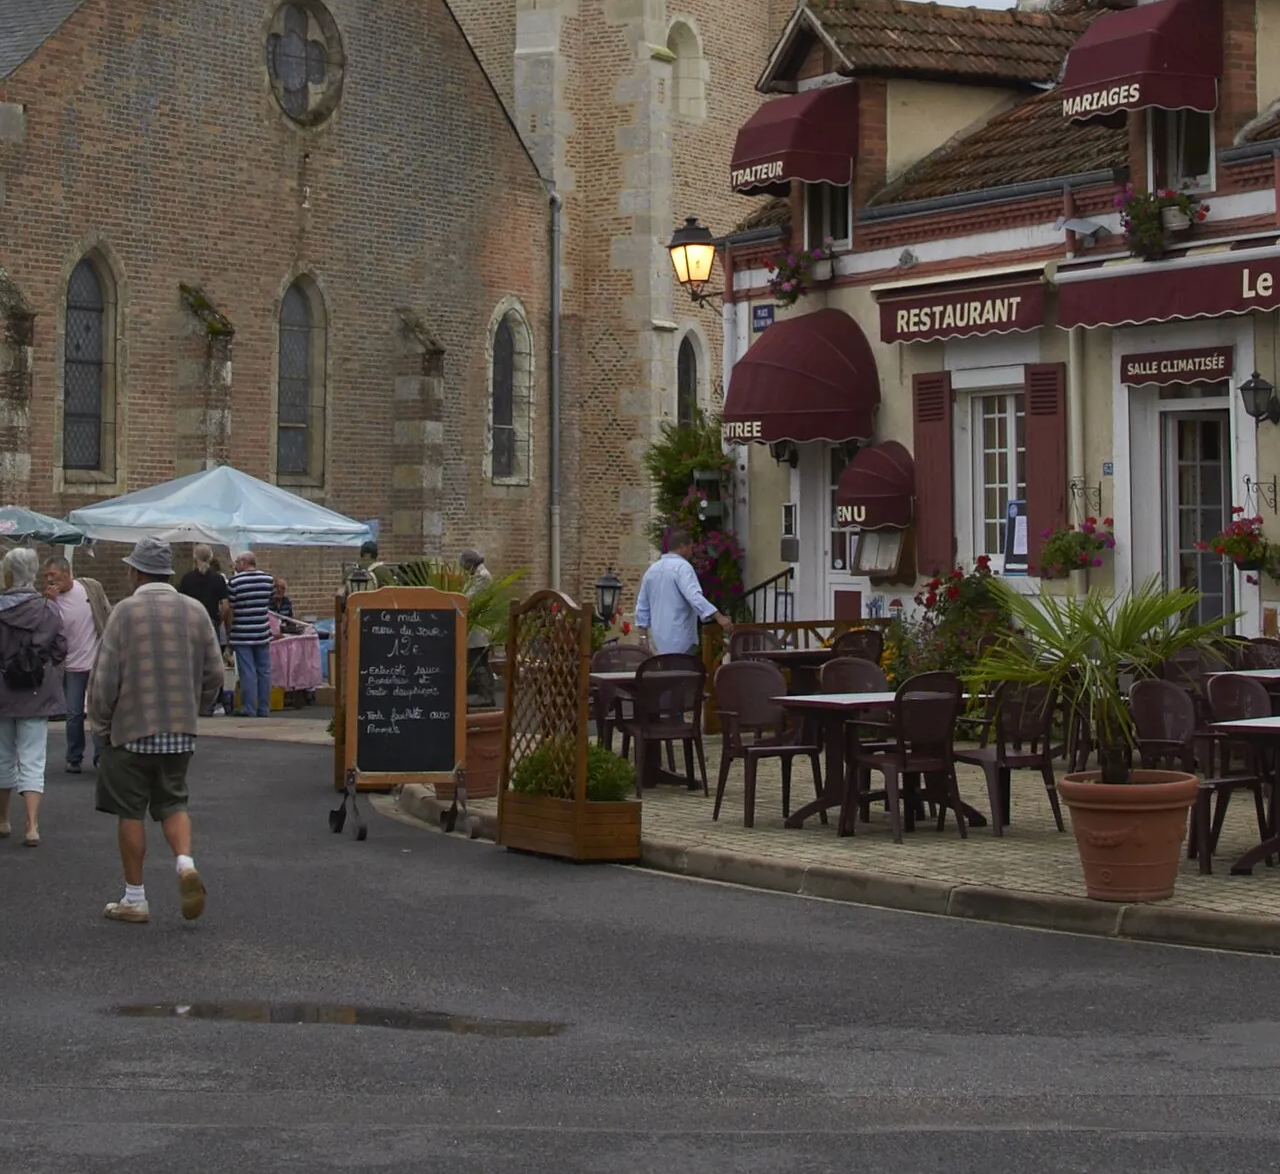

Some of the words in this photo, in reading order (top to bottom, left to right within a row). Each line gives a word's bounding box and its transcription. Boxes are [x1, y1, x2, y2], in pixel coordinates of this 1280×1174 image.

[1063, 84, 1140, 117] MARIAGES
[732, 161, 783, 186] TRAITEUR
[1242, 269, 1272, 298] Le
[897, 297, 1021, 333] RESTAURANT
[1127, 362, 1158, 376] SALLE
[1160, 352, 1225, 373] CLIMATISÉE
[836, 505, 866, 522] ENU
